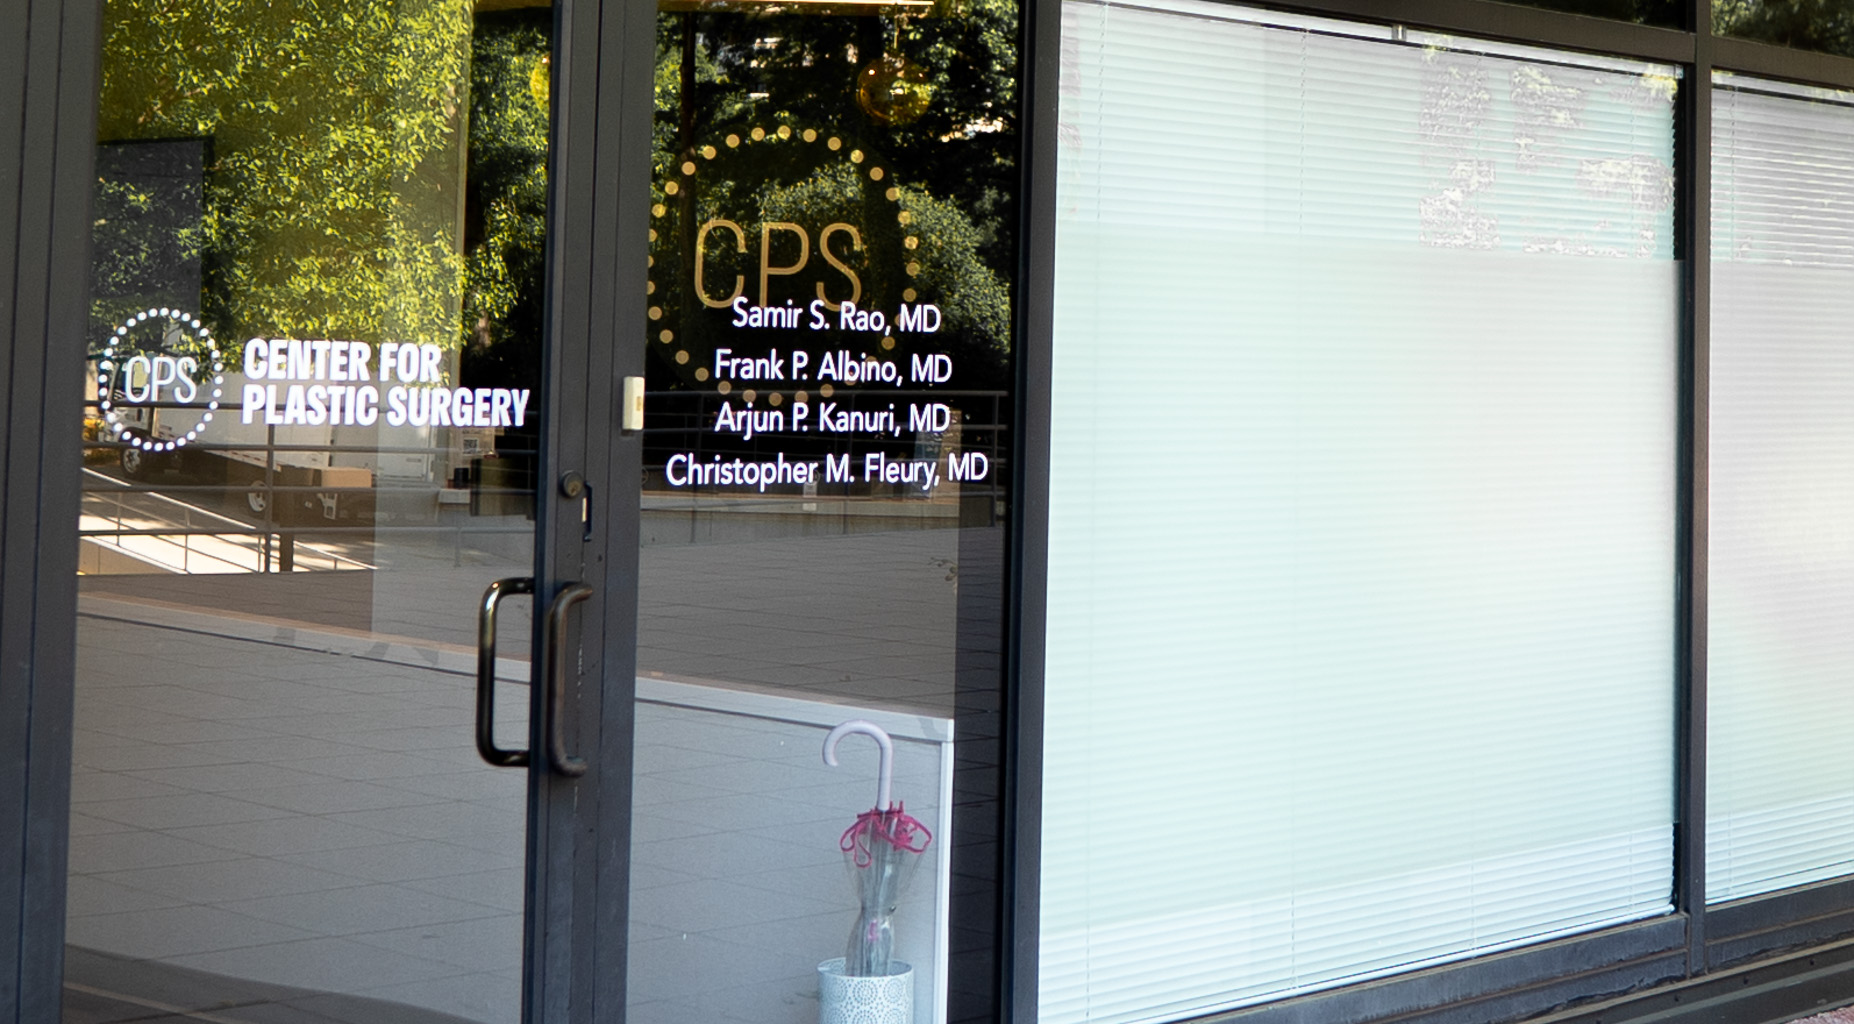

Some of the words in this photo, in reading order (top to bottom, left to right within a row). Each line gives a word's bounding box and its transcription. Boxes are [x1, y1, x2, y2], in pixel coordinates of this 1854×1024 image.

[694, 219, 863, 312] CPS
[732, 296, 803, 329] Samir
[809, 300, 830, 330] S.
[840, 301, 891, 336] Rao,
[899, 303, 942, 333] MD
[124, 355, 198, 404] CPS
[242, 337, 372, 382] CENTER
[379, 343, 443, 383] FOR
[714, 348, 784, 381] Frank
[792, 350, 808, 381] P.
[817, 350, 903, 386] Albino,
[911, 353, 952, 383] MD
[241, 384, 378, 427] PLASTIC
[386, 387, 530, 427] SURGERY
[714, 401, 784, 441] Arjun
[792, 402, 808, 432] P.
[819, 402, 900, 437] Kanuri,
[909, 403, 951, 433] MD
[665, 452, 818, 492] Christopher
[826, 453, 854, 483] M.
[864, 451, 940, 490] Fleury,
[948, 452, 989, 481] MD
